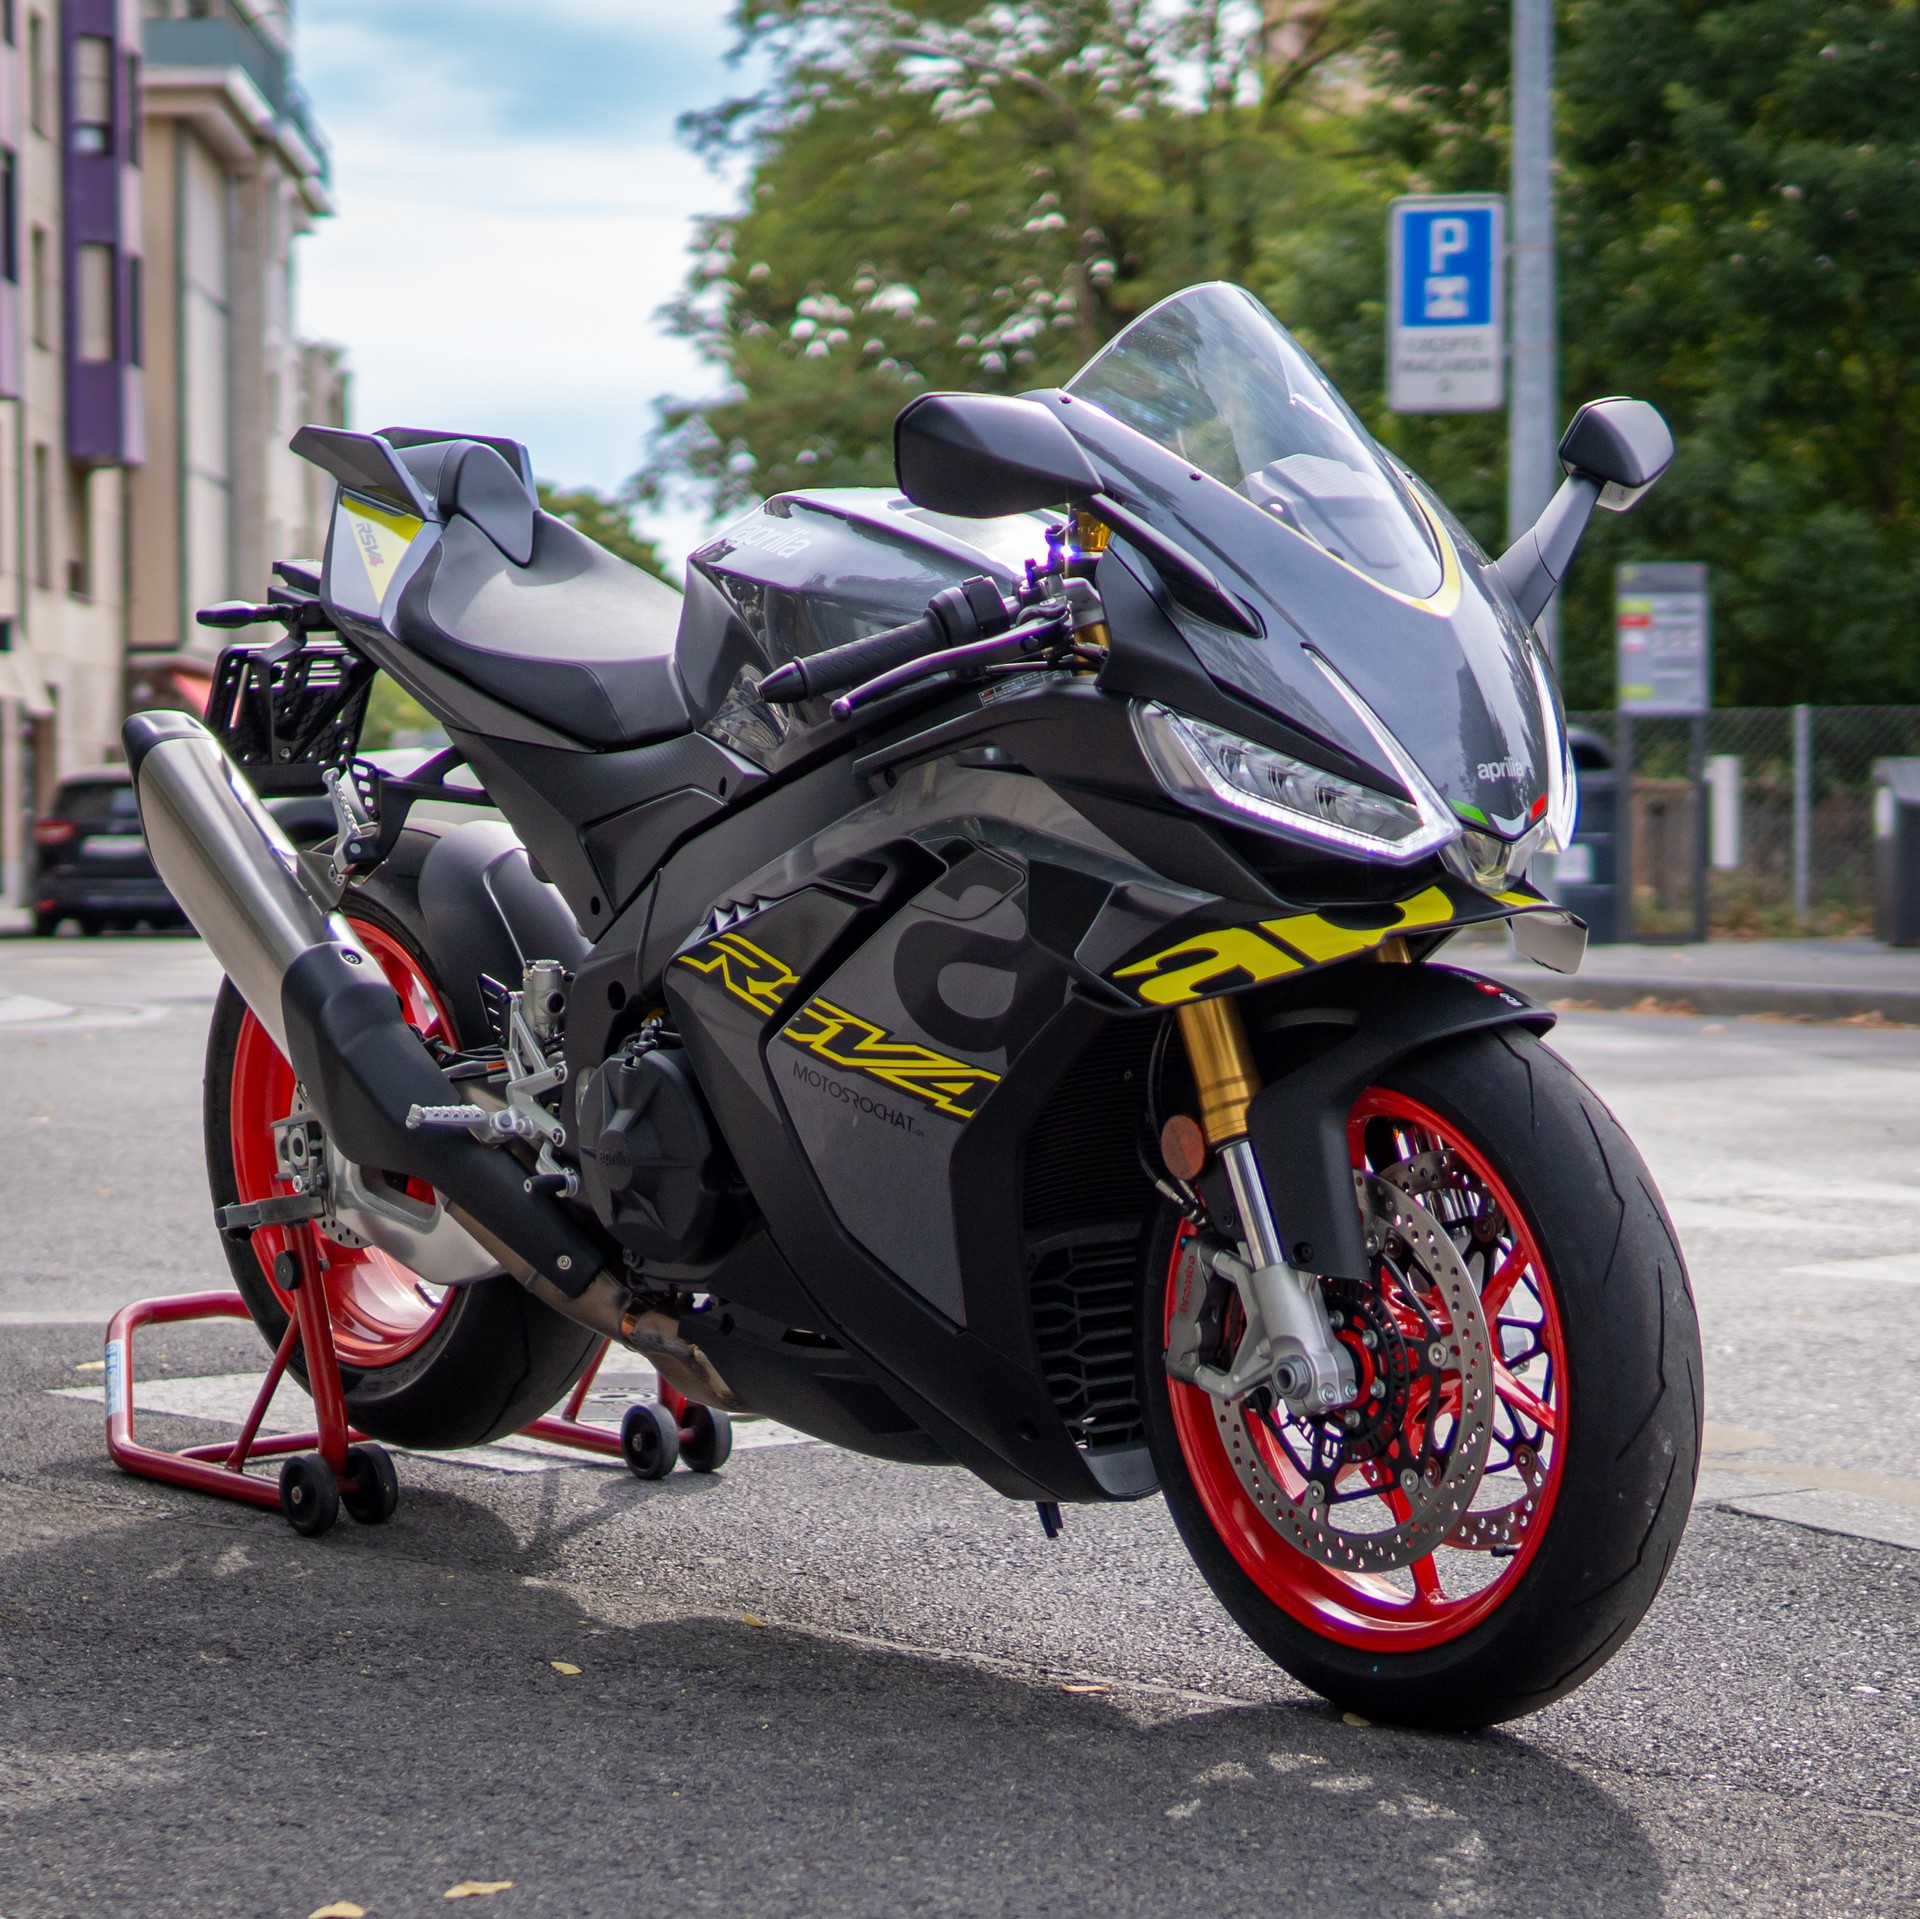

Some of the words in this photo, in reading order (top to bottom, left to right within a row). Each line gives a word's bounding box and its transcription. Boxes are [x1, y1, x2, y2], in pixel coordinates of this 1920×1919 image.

[1429, 218, 1469, 274] P
[356, 522, 385, 567] RSV4
[1477, 756, 1525, 782] aprilia
[1179, 1255, 1196, 1314] brembo
